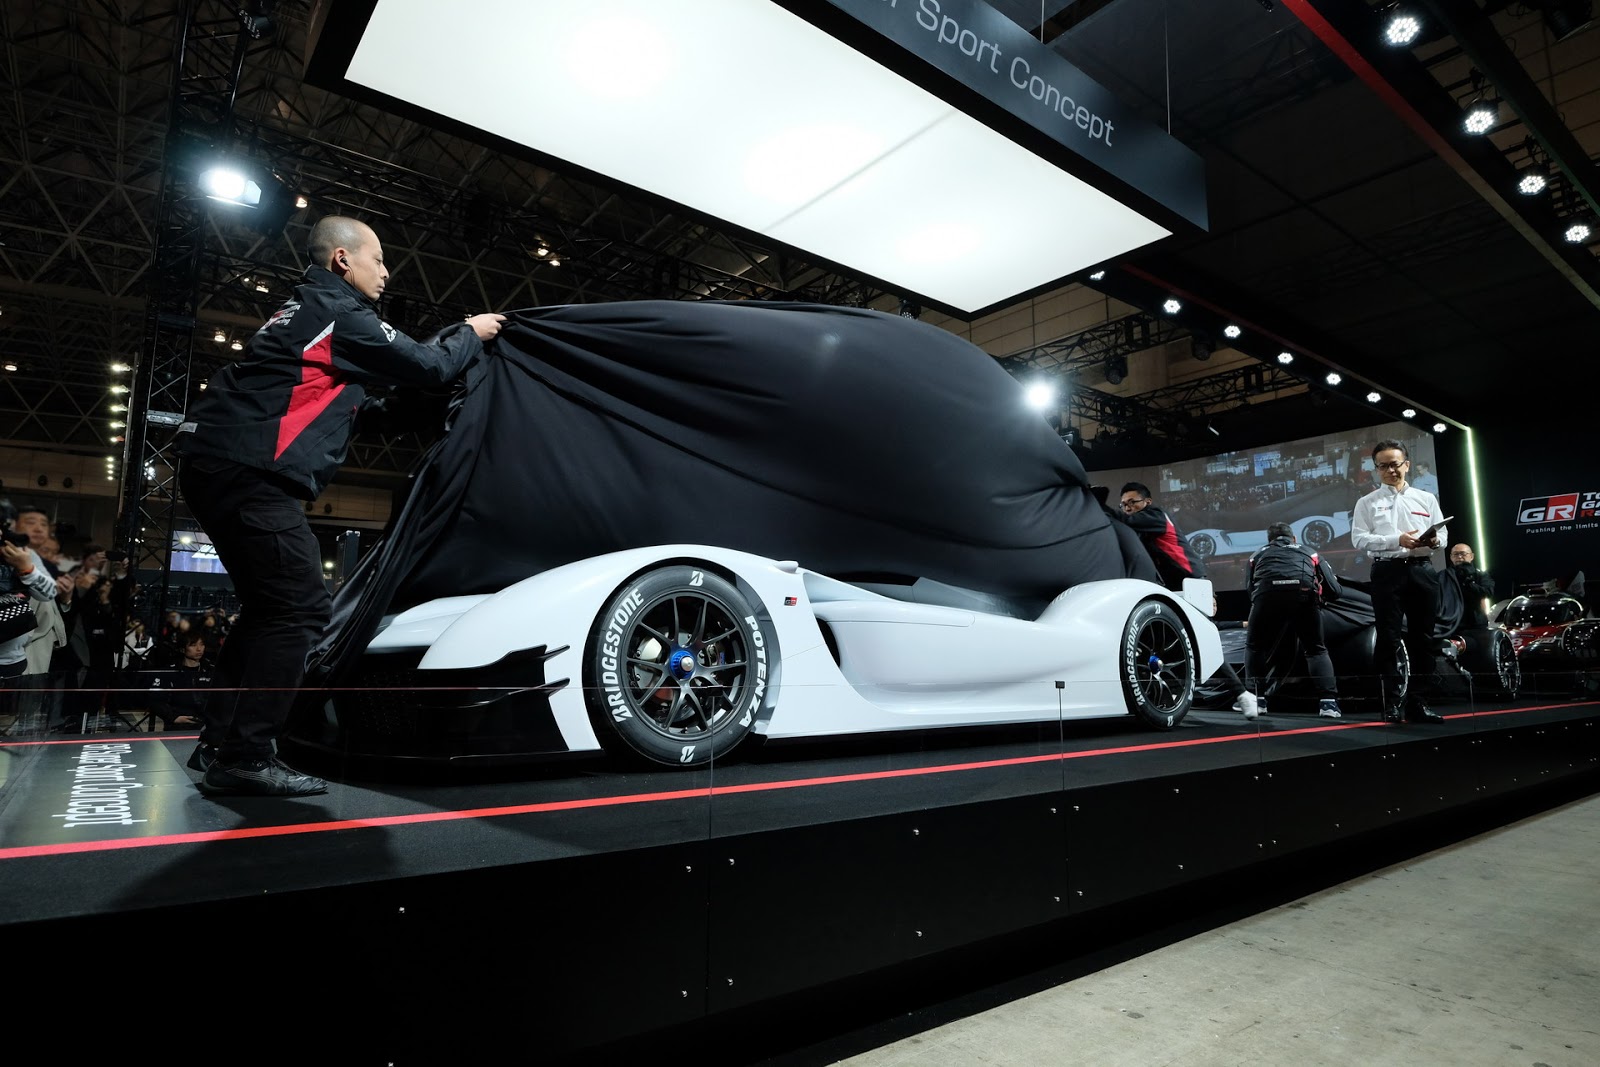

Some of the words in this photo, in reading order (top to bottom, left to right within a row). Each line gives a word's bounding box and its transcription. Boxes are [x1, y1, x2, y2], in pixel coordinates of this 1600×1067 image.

[916, 0, 1002, 74] Sport
[1009, 56, 1114, 147] Concept
[1519, 503, 1574, 523] GR
[601, 588, 645, 723] BRIDGESTONE
[739, 615, 768, 728] POTENZA
[1126, 620, 1146, 706] BRIDGESTONE
[1181, 628, 1196, 700] POTENZA
[66, 763, 137, 783] Sport
[72, 750, 133, 763] Super
[51, 782, 148, 828] Concept
